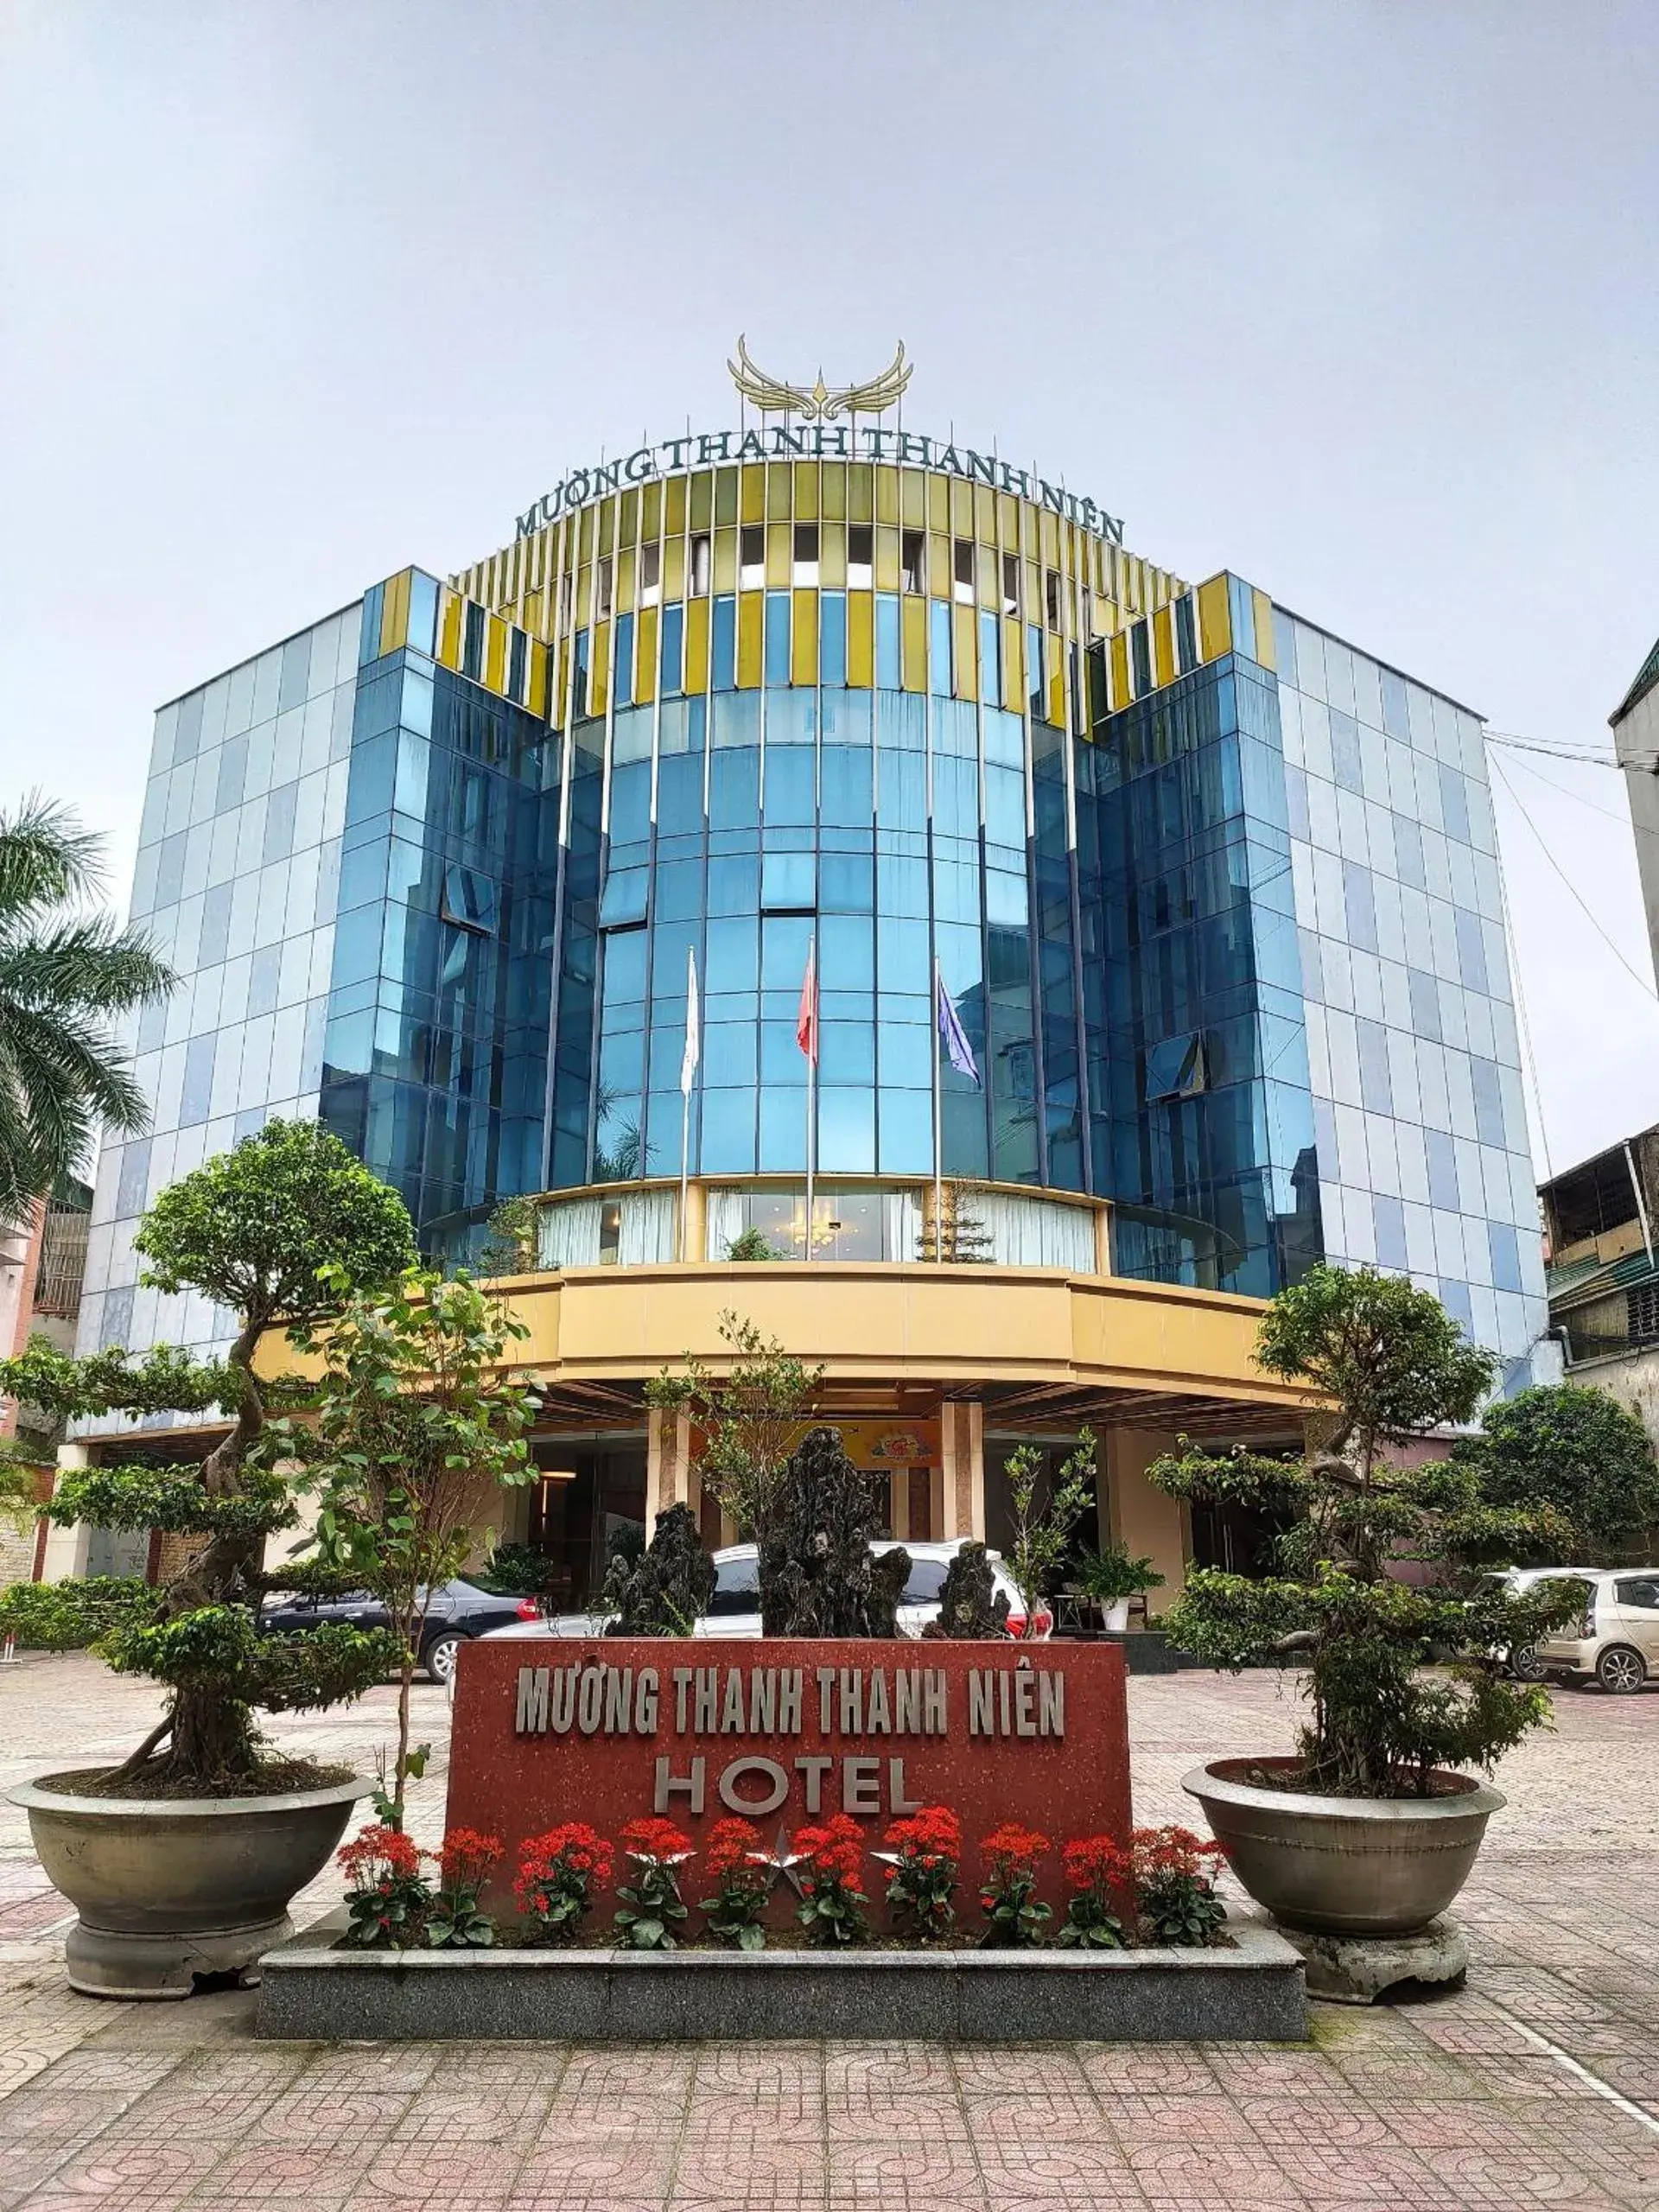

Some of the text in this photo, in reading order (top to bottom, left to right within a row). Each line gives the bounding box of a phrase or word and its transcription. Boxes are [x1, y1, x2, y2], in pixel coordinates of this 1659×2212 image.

[516, 425, 1125, 546] MƯỜNG THANH THANH NIÊN
[672, 1667, 803, 1735] THANH
[817, 1667, 948, 1735] THANH
[969, 1656, 1065, 1736] NIÊN
[653, 1755, 924, 1815] HOTEL
